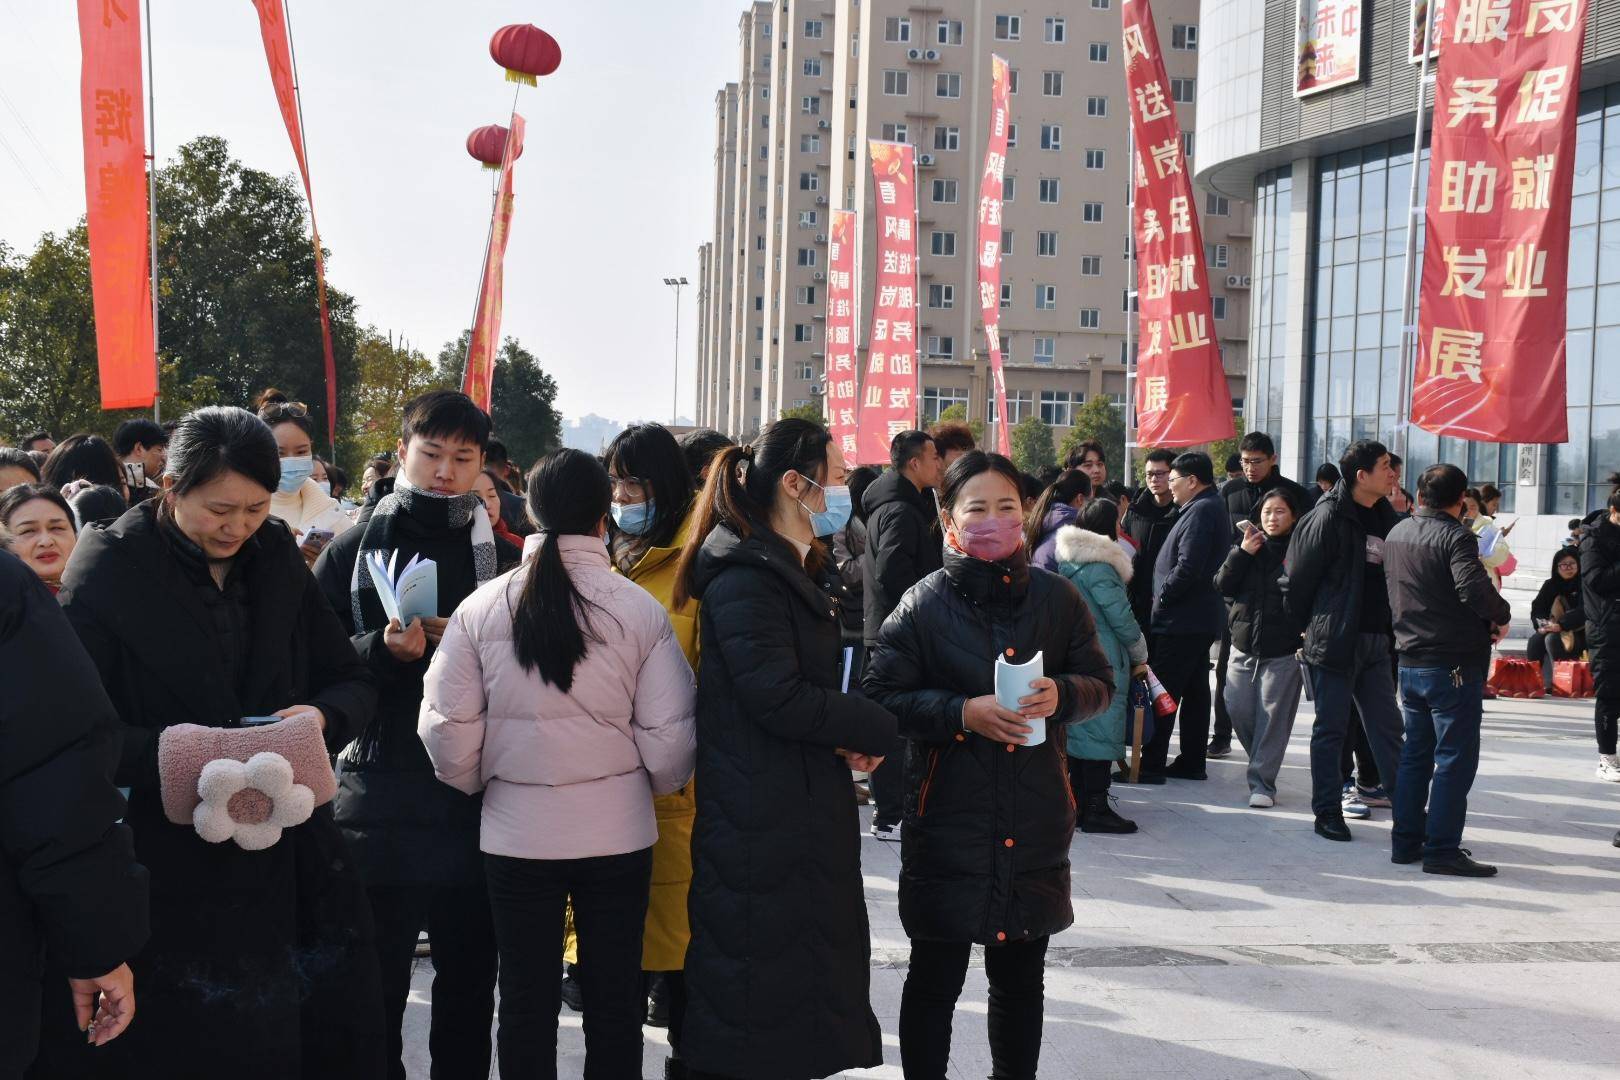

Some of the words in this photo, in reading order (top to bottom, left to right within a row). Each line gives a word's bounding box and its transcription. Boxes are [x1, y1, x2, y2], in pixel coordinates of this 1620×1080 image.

[1427, 0, 1512, 384] 服务助发展
